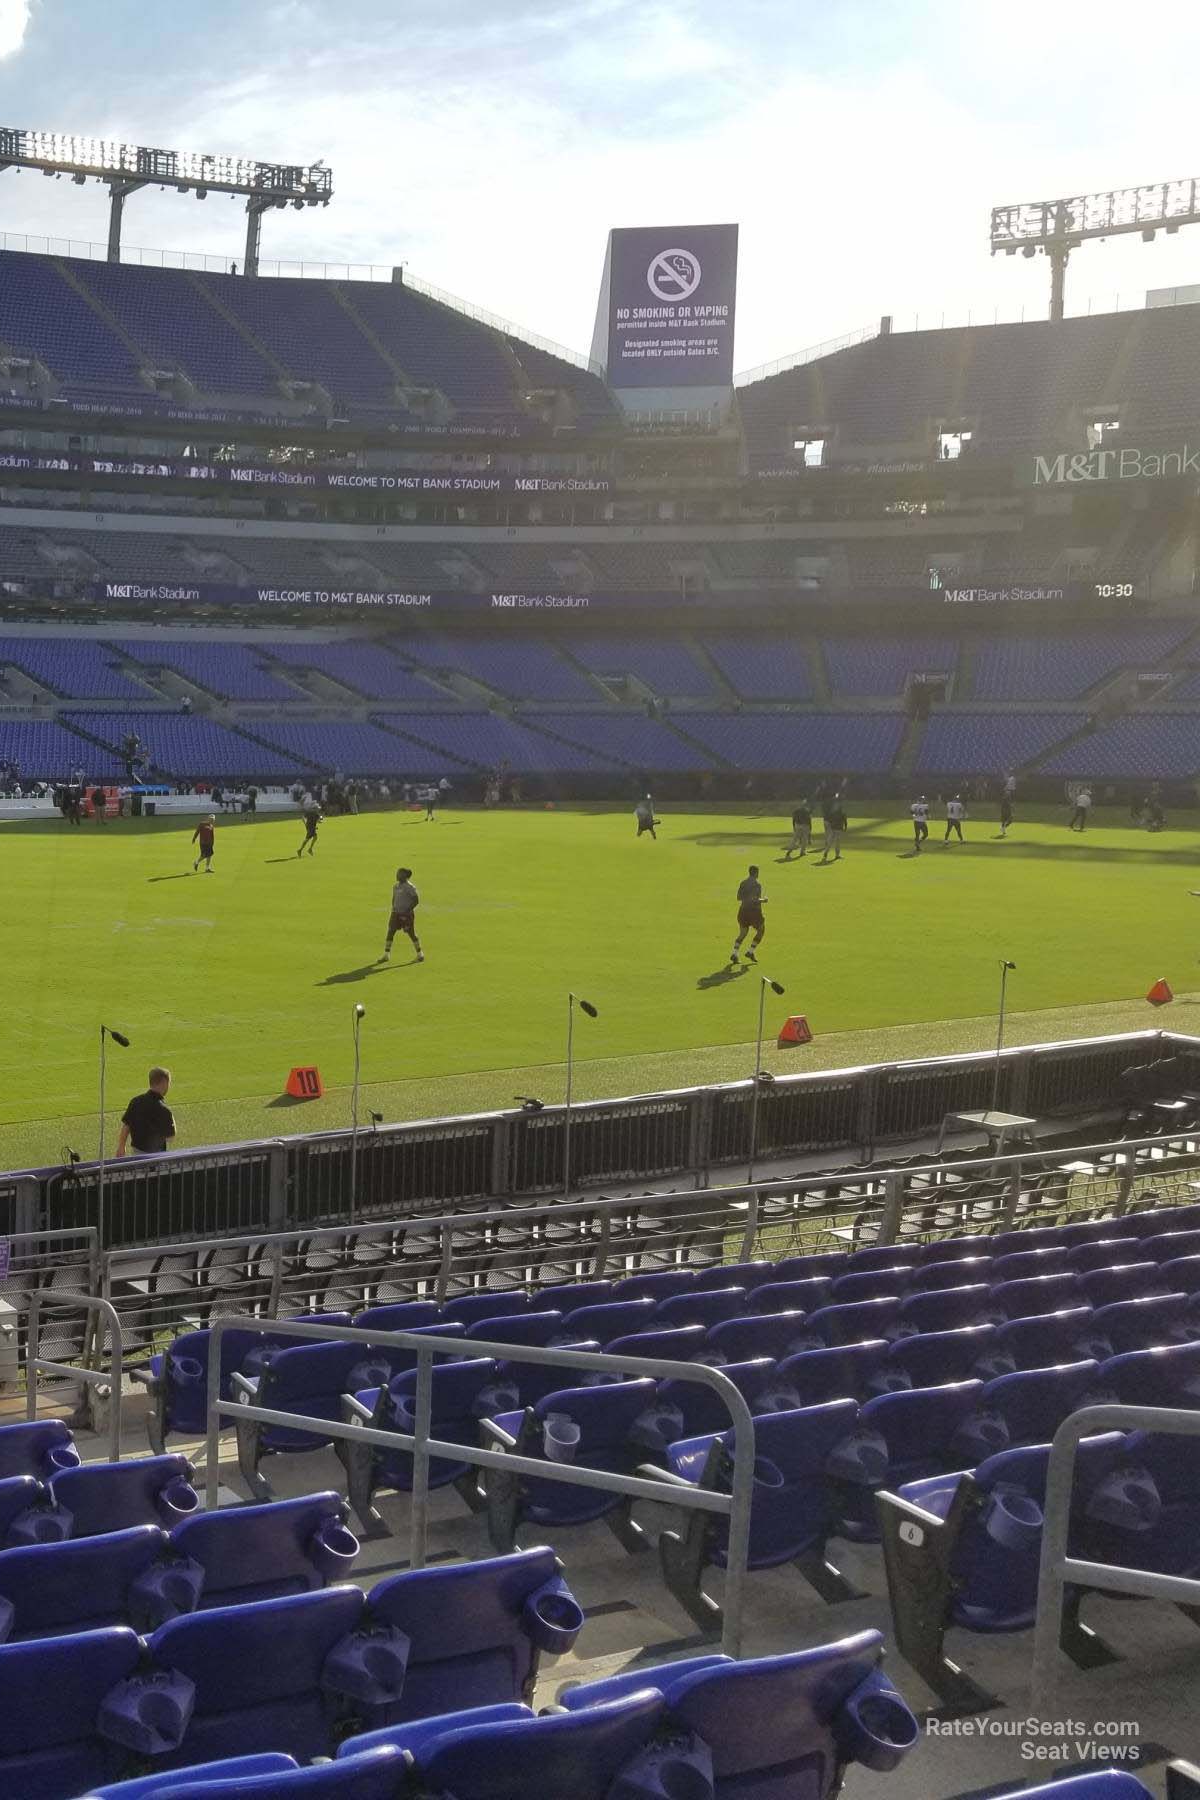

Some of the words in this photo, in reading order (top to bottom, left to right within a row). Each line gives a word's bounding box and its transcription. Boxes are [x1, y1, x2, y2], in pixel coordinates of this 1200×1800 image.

[616, 307, 630, 319] NO
[633, 306, 675, 319] SMOKING
[678, 306, 691, 317] OR
[694, 304, 729, 317] VAPING
[616, 321, 647, 329] permitted
[648, 320, 667, 328] inside
[669, 320, 681, 328] M&T
[683, 319, 699, 327] Bank
[625, 339, 660, 349] Designated
[661, 339, 687, 348] smoking
[688, 339, 706, 347] areas
[622, 349, 645, 358] located
[646, 348, 662, 357] ONLY
[663, 348, 686, 357] outside
[688, 347, 706, 356] Gates
[1032, 451, 1117, 485] M&T
[1120, 444, 1200, 479] Bank
[231, 468, 255, 481] M&T
[255, 470, 277, 483] Bank
[278, 471, 316, 485] Stadium
[327, 475, 378, 488] WELCOME
[380, 476, 395, 488] TO
[398, 477, 420, 488] M&T
[423, 478, 452, 489] BANK
[454, 478, 500, 490] STADIUM
[514, 479, 541, 491] M&T
[541, 480, 566, 491] Bank
[567, 479, 609, 491] Stadium
[106, 584, 133, 598] M&T
[133, 585, 158, 598] Bank
[158, 586, 200, 600] Stadium
[257, 589, 311, 602] WELCOME
[314, 591, 329, 603] TO
[332, 592, 354, 603] M&T
[356, 593, 384, 604] BANK
[386, 593, 431, 606] STADIUM
[943, 590, 976, 602] M&T
[976, 588, 1009, 601] Bank
[1011, 587, 1063, 601] Stadium
[491, 594, 518, 607] M&T
[518, 595, 544, 607] Bank
[544, 595, 589, 608] Stadium
[296, 1070, 319, 1094] 10
[908, 1528, 914, 1540] 6
